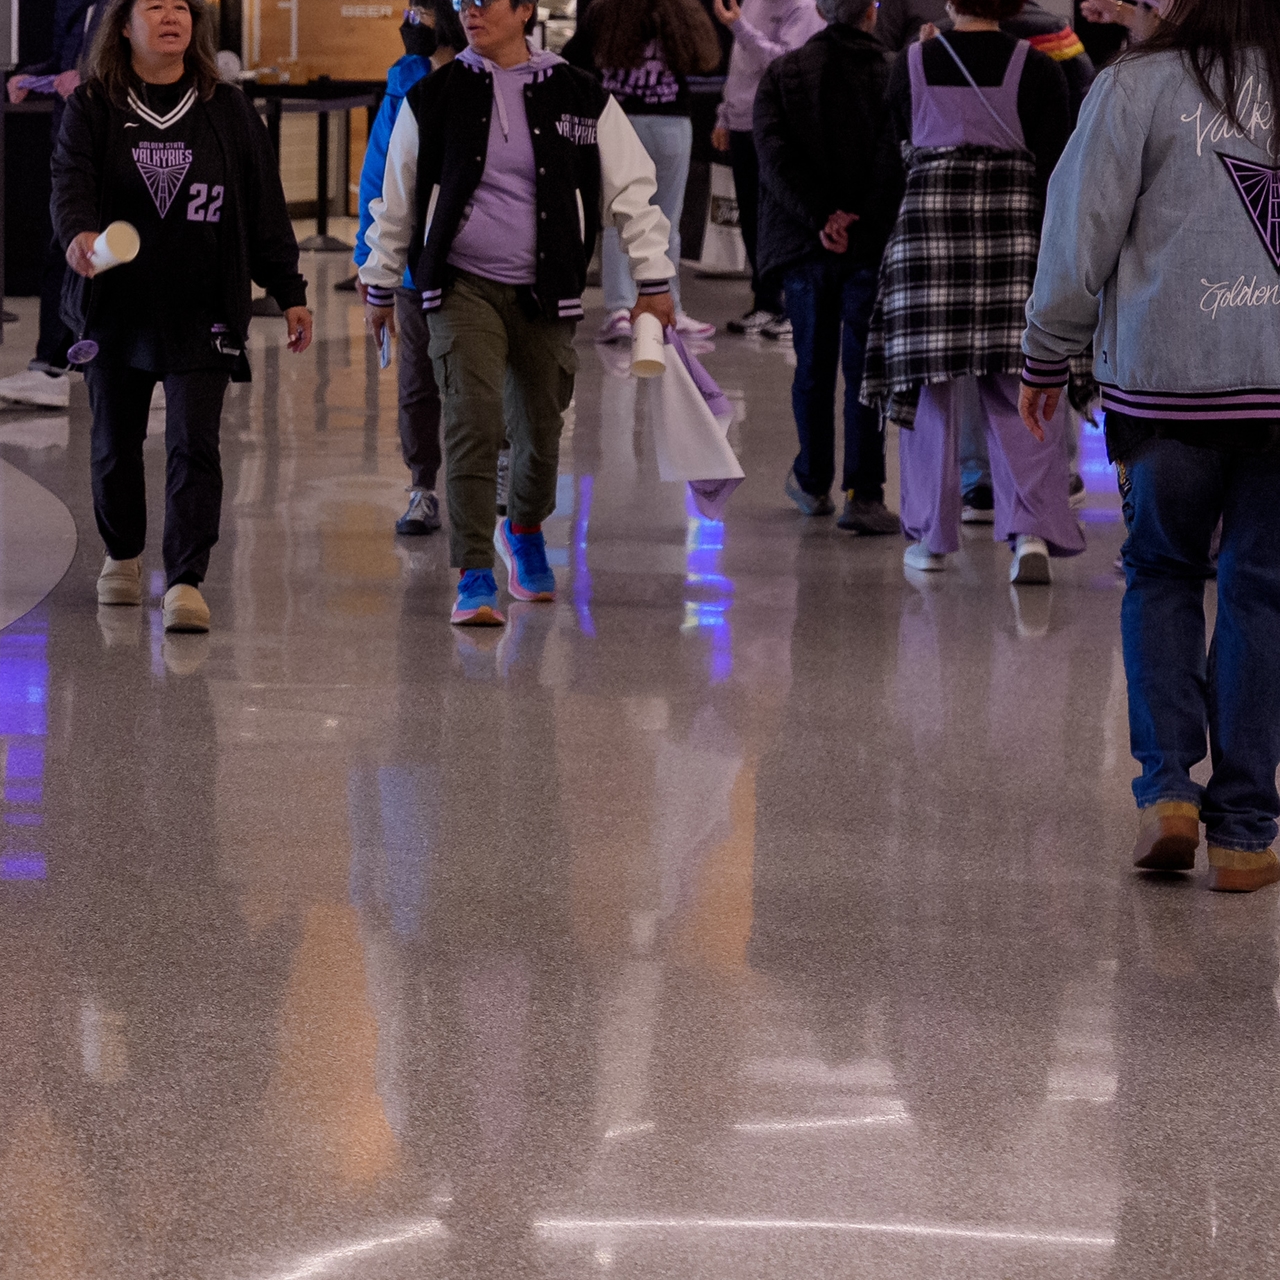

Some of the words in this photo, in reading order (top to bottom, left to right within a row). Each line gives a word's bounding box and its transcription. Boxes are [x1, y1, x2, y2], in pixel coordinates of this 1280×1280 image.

[341, 4, 393, 18] BEER
[139, 141, 164, 149] GOLDEN
[132, 148, 193, 168] VALKYRIES
[187, 183, 225, 223] 22
